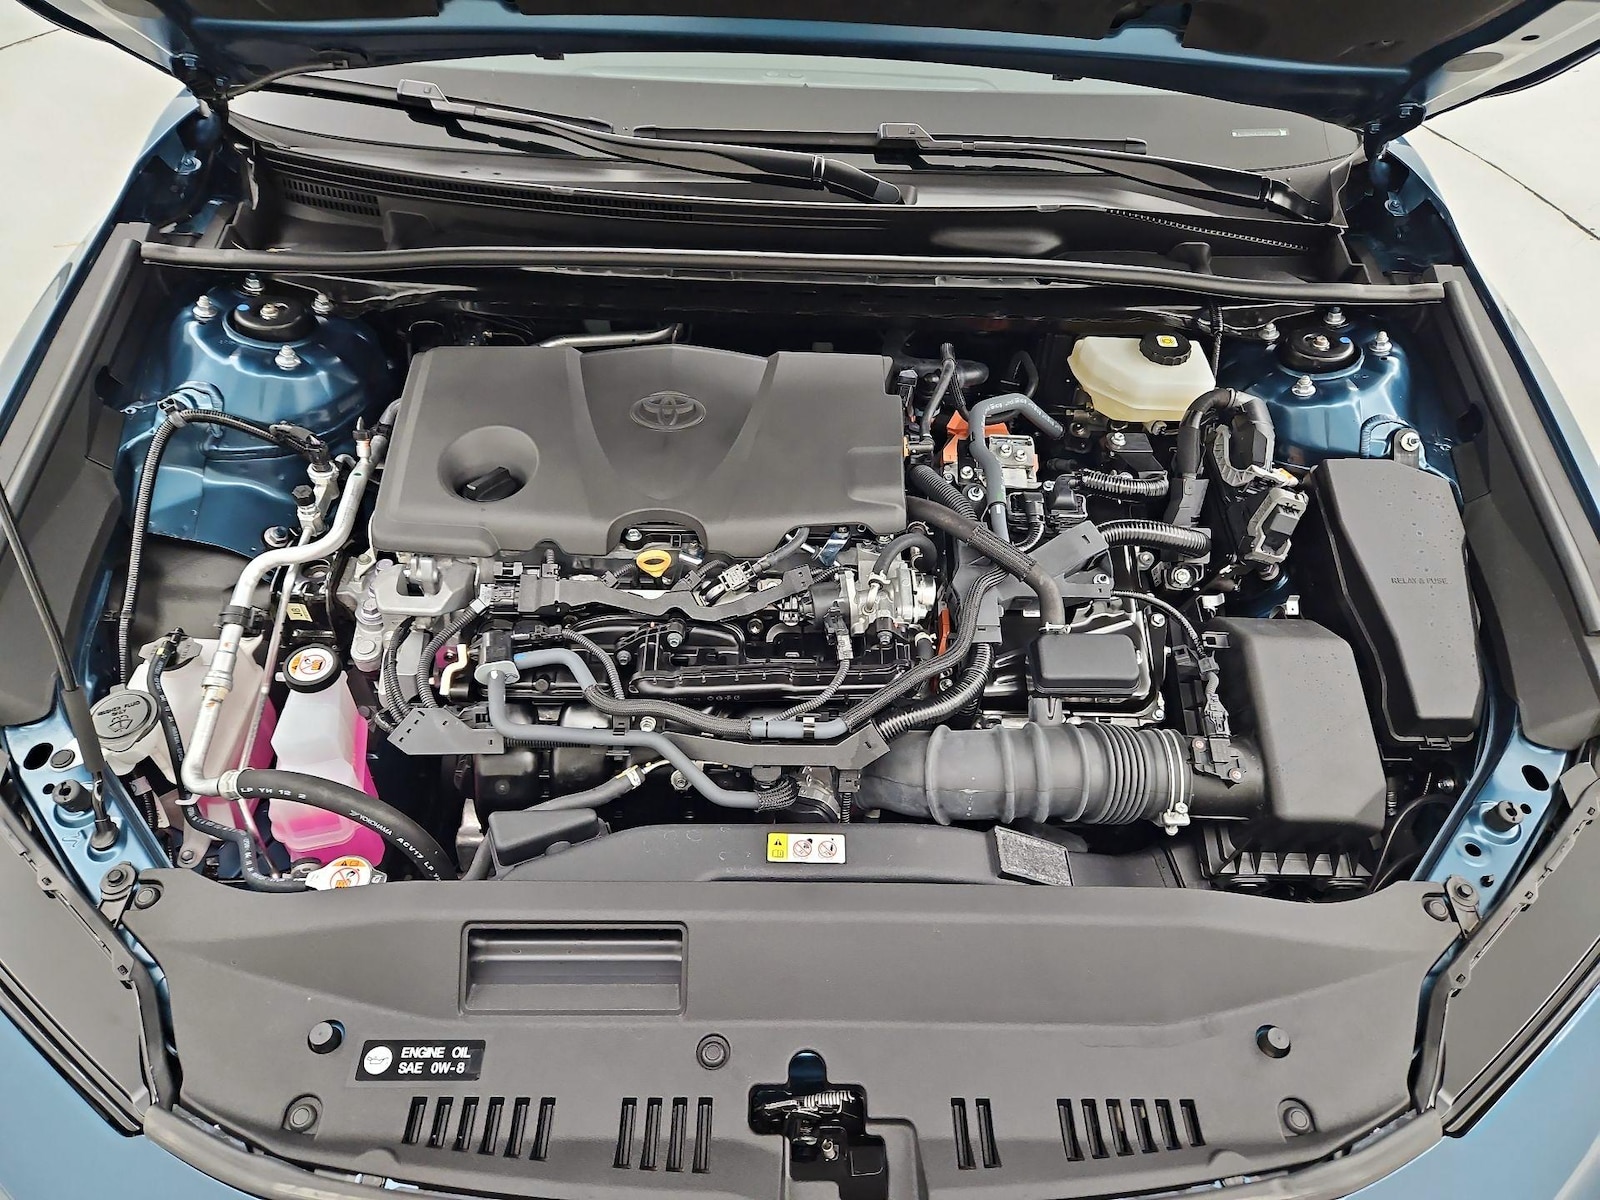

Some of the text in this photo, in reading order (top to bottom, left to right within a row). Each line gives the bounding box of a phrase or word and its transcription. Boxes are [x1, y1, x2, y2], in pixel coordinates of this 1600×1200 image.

[1391, 577, 1417, 585] RELAY
[1426, 577, 1449, 585] FUSE
[124, 700, 141, 708] FLUID
[359, 814, 393, 836] YOKOHAMA
[396, 837, 424, 859] ACV17
[423, 861, 434, 871] LP
[400, 1046, 471, 1059] ENGINE OIL
[398, 1062, 466, 1074] SAE 0W-8
